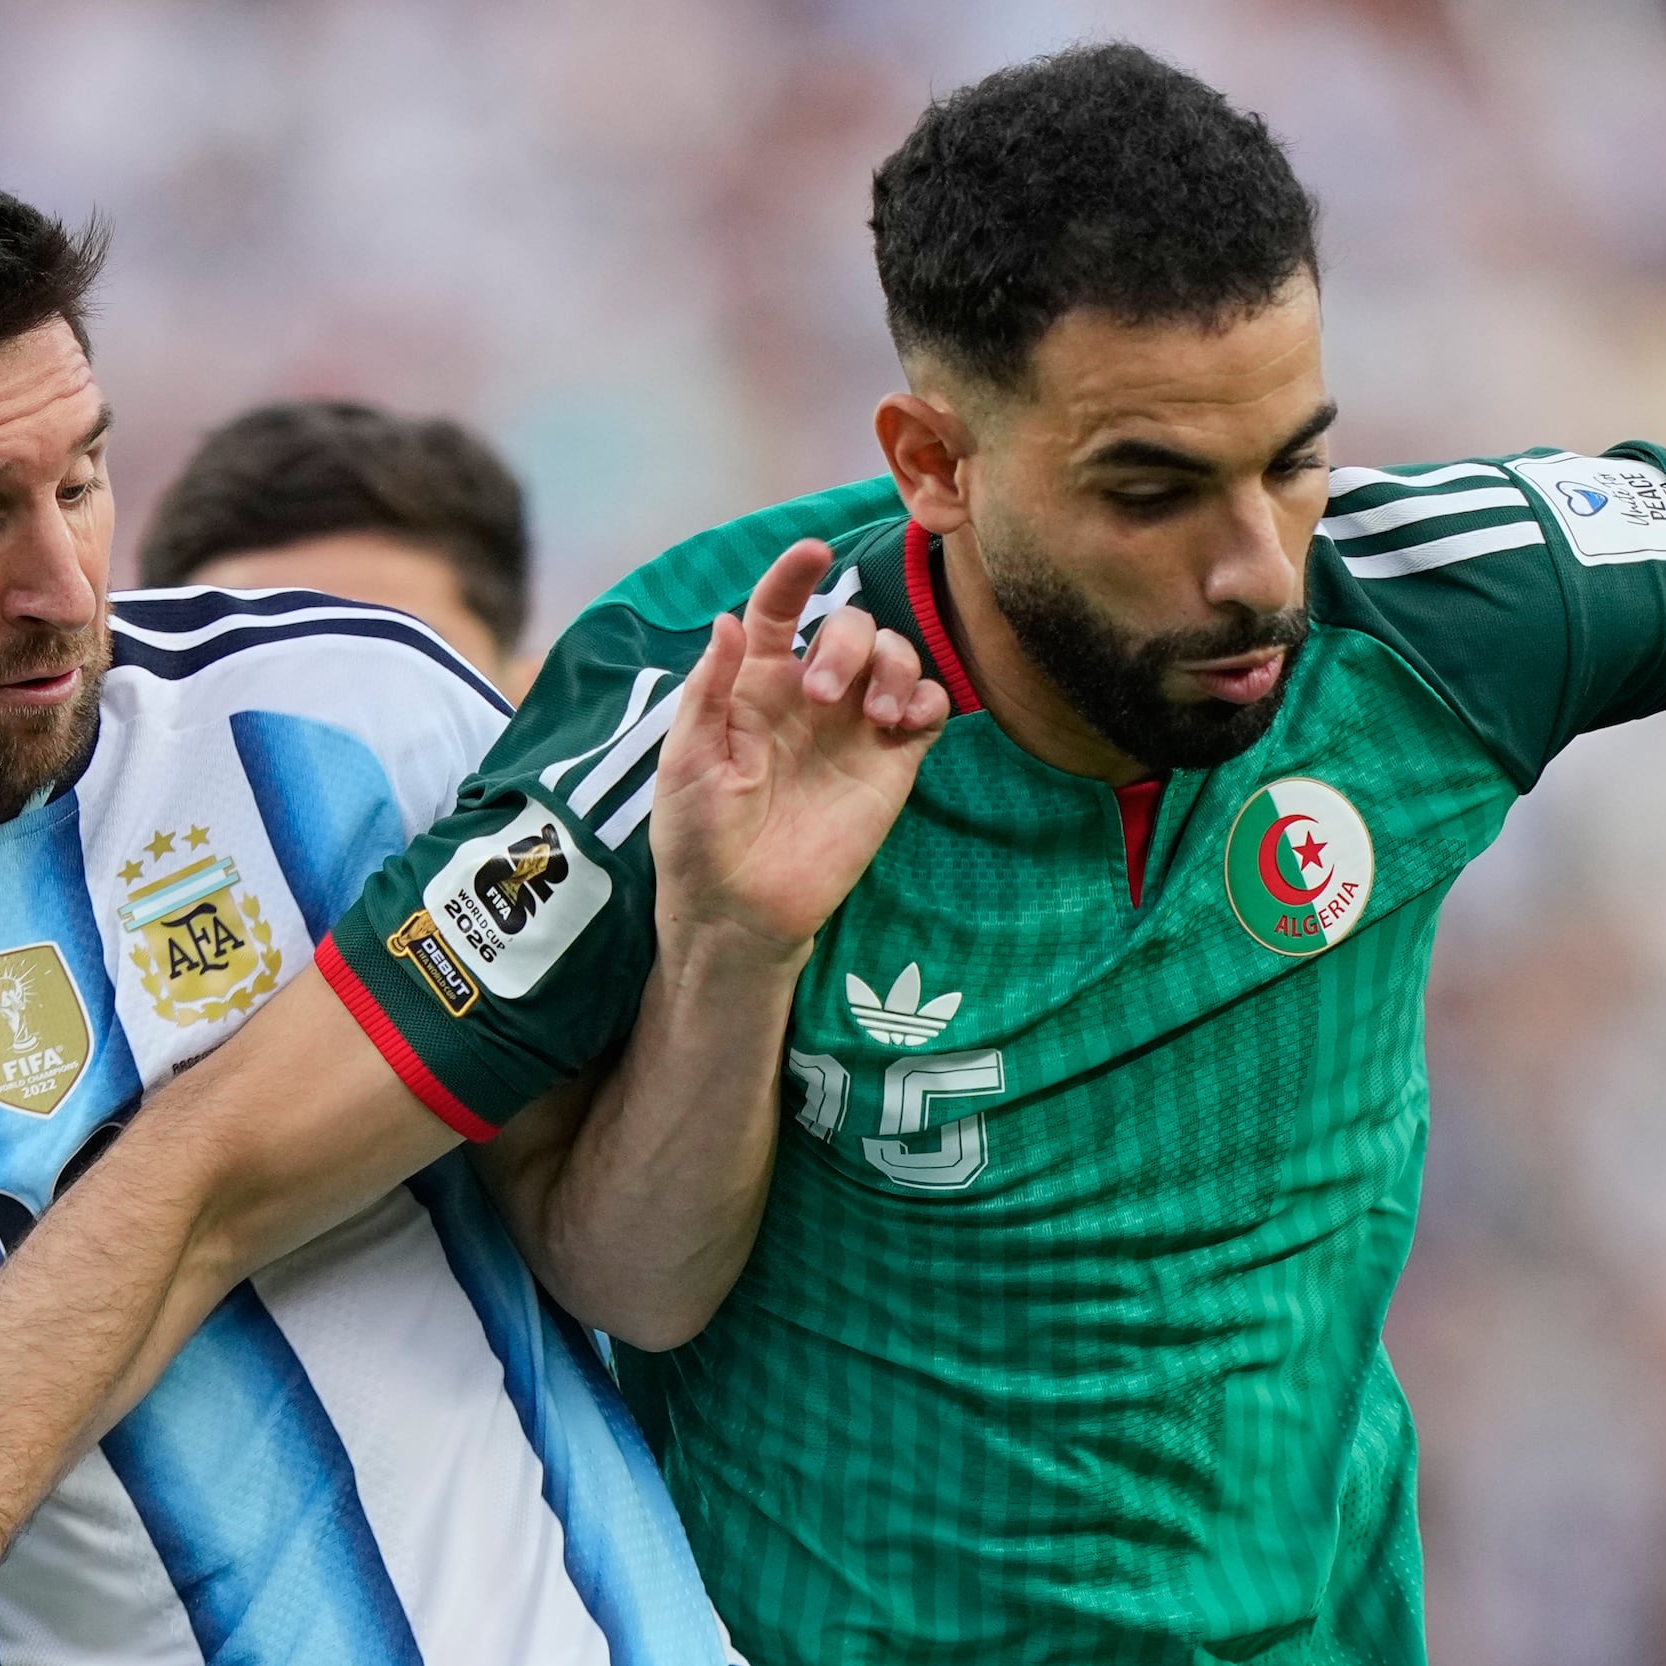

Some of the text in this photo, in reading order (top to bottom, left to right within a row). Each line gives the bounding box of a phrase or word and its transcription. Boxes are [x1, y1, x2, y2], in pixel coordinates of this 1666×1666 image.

[458, 888, 506, 950] WORLD CUP
[486, 886, 512, 921] FIFA
[1274, 880, 1360, 938] ALGERIA
[160, 902, 246, 980] AFA
[444, 899, 498, 964] 2026
[416, 948, 457, 1000] FIFA WORLD CUP
[421, 938, 471, 996] DEBUT
[2, 1046, 64, 1082] FIFA
[21, 1078, 58, 1099] 2022
[27, 1060, 79, 1084] CHAMPIONS
